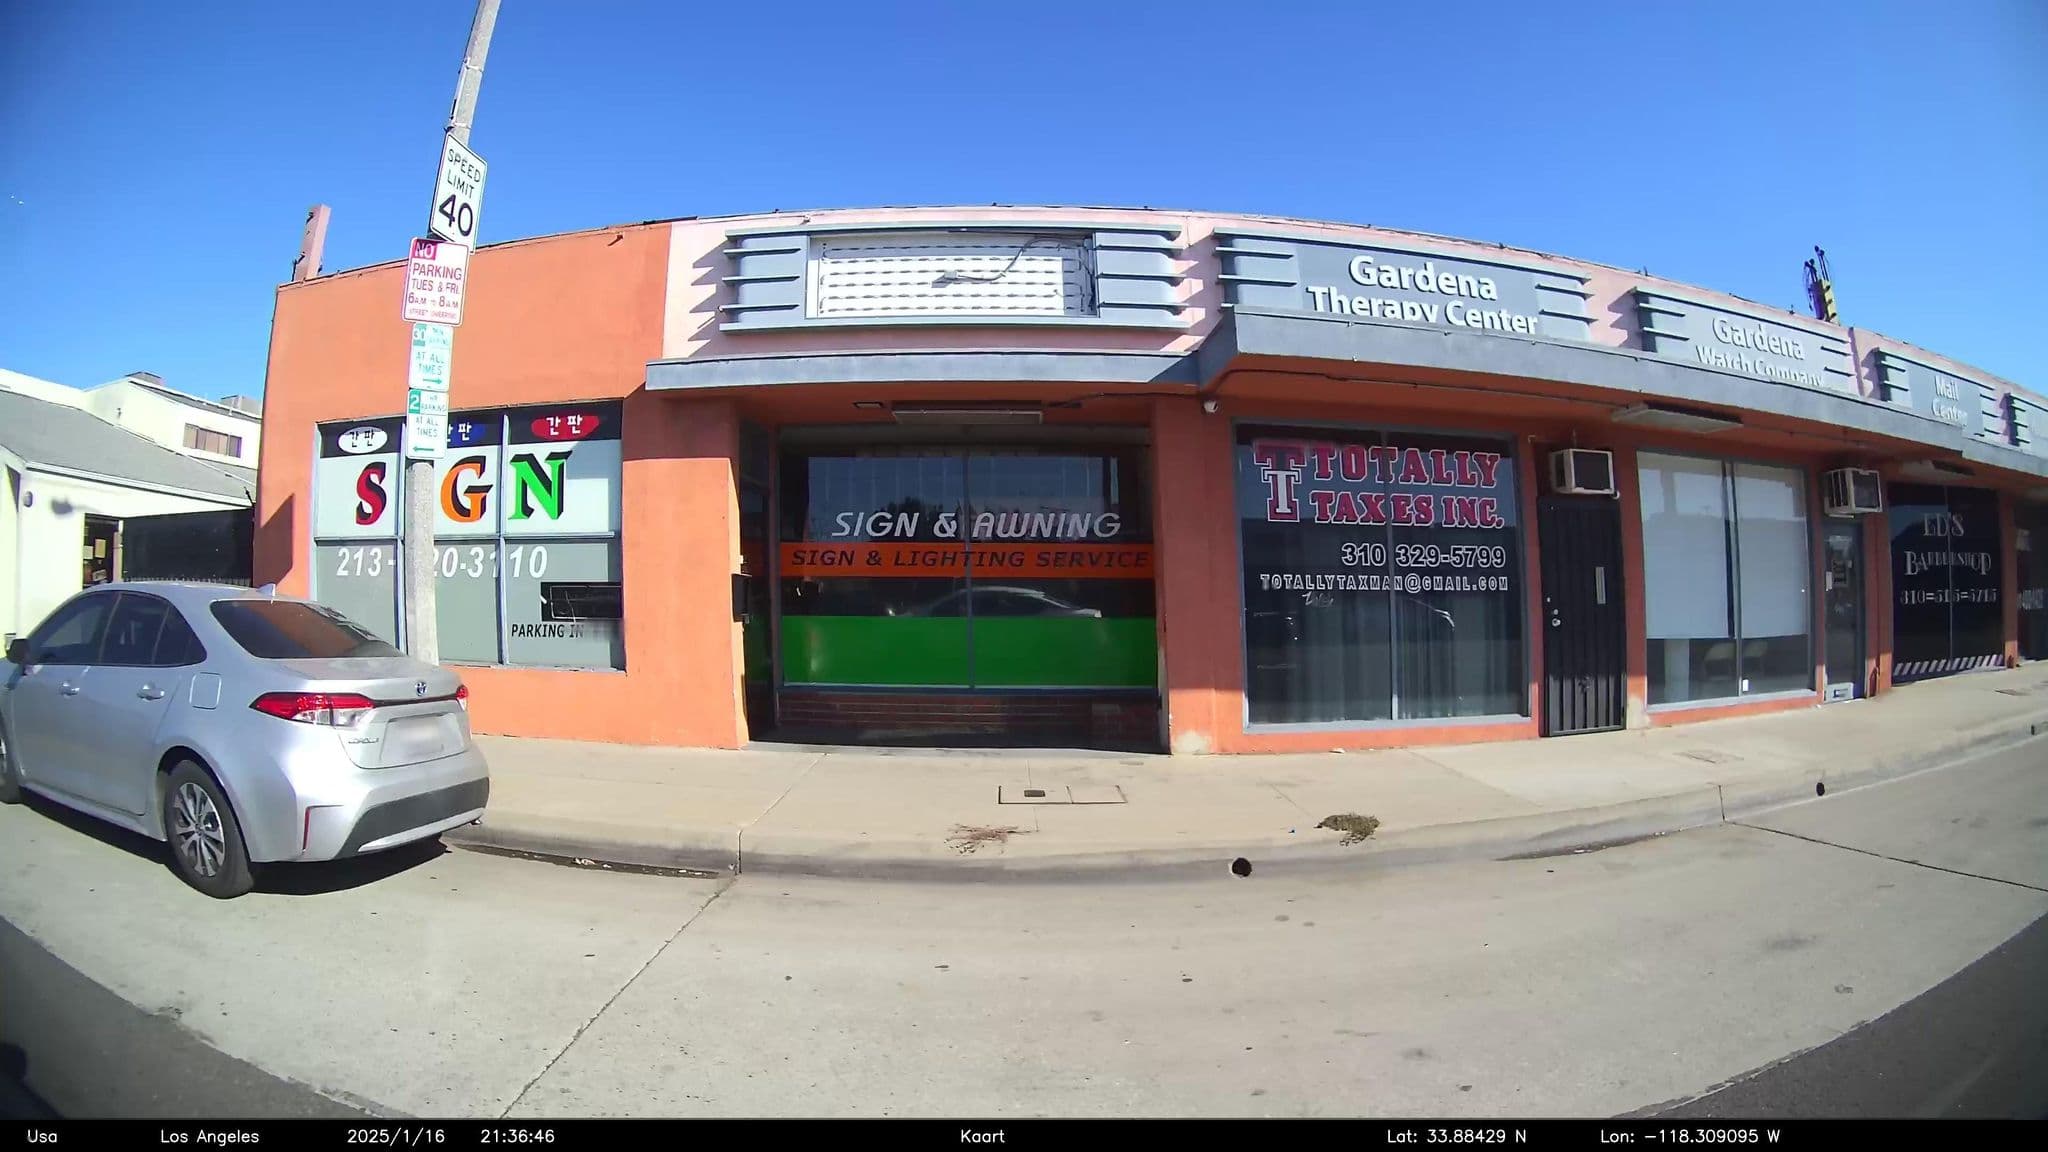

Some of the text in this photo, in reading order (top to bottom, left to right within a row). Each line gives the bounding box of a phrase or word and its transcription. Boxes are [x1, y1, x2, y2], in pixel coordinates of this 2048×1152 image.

[448, 148, 480, 183] SPEED
[447, 168, 474, 199] LIMIT
[439, 194, 473, 236] 40
[414, 241, 435, 259] NO
[412, 262, 462, 280] PARKING
[1349, 255, 1499, 301] Gardena
[412, 278, 434, 292] TUES
[438, 282, 443, 292] &
[1444, 300, 1538, 335] Center
[1712, 317, 1804, 360] Gardena
[1695, 345, 1823, 387] Watch Company
[1934, 374, 1958, 401] Mail
[410, 394, 418, 410] 2
[418, 428, 438, 438] TIMES
[546, 414, 583, 436] 간판
[350, 429, 374, 448] 간판
[1311, 444, 1500, 488] TOTALLY
[355, 450, 572, 525] SGN
[1310, 490, 1504, 528] TAXES INC.
[832, 512, 1122, 538] SIGN & AWNING
[336, 546, 548, 578] 213-0-310
[792, 550, 1150, 568] SIGN & LIGHTING SERVICE
[1342, 543, 1506, 568] 310 329-5799
[1260, 574, 1509, 594] TOTALLYTAXMAN@GMAIL.COM
[512, 624, 565, 638] PARKING
